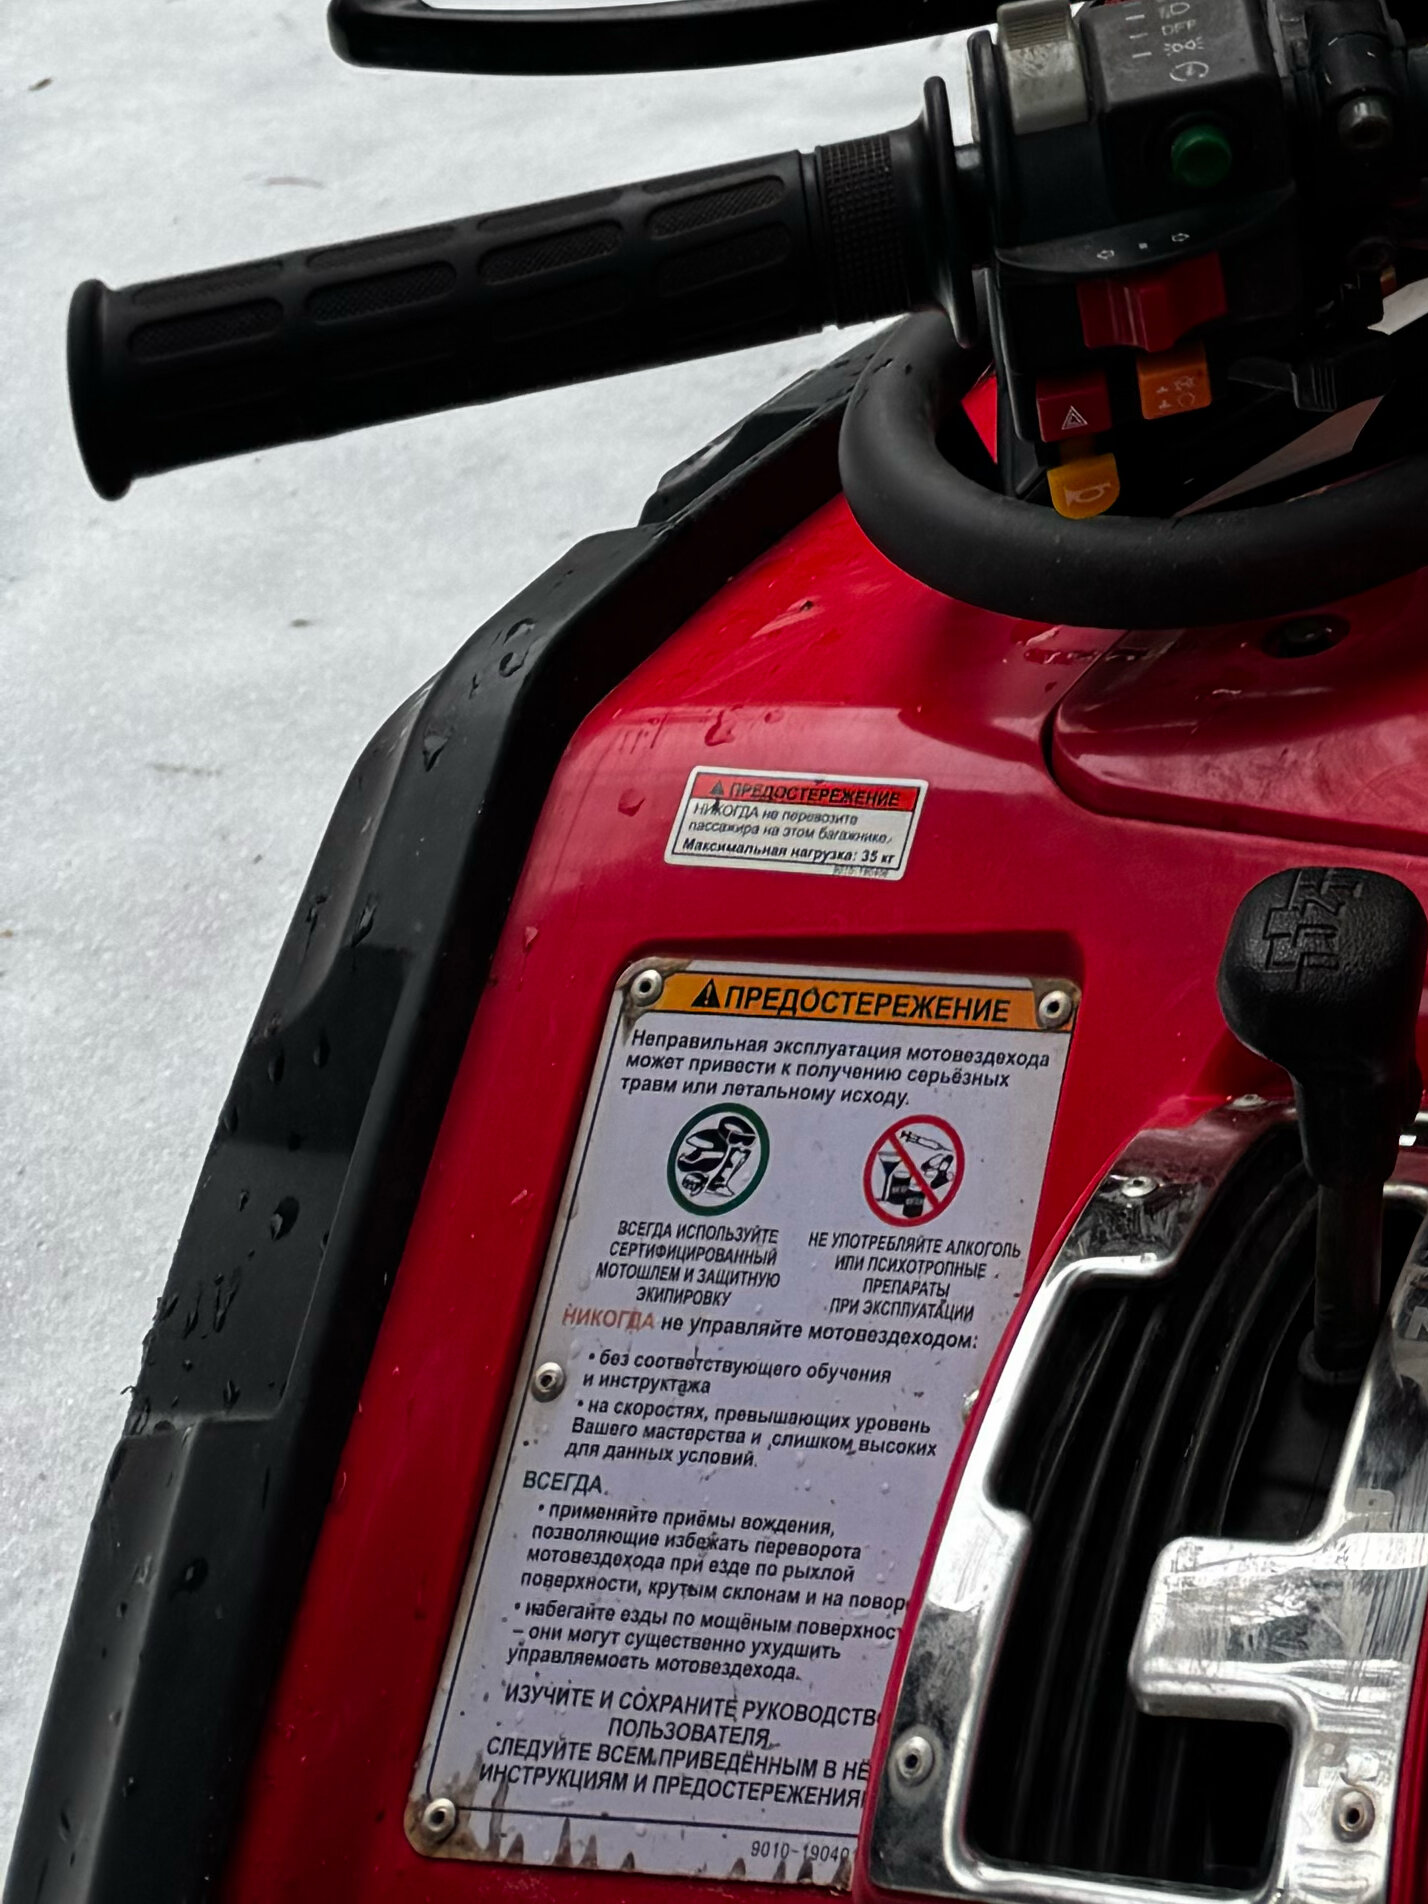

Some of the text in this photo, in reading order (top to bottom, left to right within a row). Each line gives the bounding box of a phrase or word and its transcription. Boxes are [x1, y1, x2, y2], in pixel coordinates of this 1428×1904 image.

[730, 782, 901, 807] ПРЕДОСТЕРЕЖЕНИЕ
[683, 838, 787, 857] Максимальная
[862, 849, 878, 863] 35
[882, 852, 895, 863] кг
[725, 986, 1011, 1023] ПРЕДОСТЕРЕЖЕНИЕ
[631, 1029, 1050, 1069] Неправильная эксплуатация мотовездехода
[625, 1054, 1010, 1088] может привести к получению серьёзных
[620, 1075, 910, 1108] травм или летальному исходу.
[617, 1220, 779, 1245] ВСЕГДА ИСПОЛЬЗУЙТЕ
[808, 1231, 1020, 1259] НЕ УПОТРЕБЛЯЙТЕ АЛКОГОЛЬ
[609, 1241, 778, 1267] СЕРТИФИЦИРОВАННЫЙ
[835, 1255, 985, 1279] ИЛИ ПСИХОТРОПНЫЕ
[596, 1263, 781, 1289] МОТОШЛЕМ И ЗАЩИТНУЮ
[862, 1278, 950, 1298] ПРЕПАРАТЫ
[636, 1286, 731, 1308] ЭКИПИРОВКУ
[829, 1298, 974, 1323] ПРИ ЭКСПЛУАТАЦИИ
[563, 1304, 977, 1351] НИКОГДА не управляйте мотовездеходом:
[600, 1350, 892, 1384] без соответствующего обучения
[583, 1374, 710, 1395] и инструктажа
[588, 1400, 931, 1435] на скоростях, превышающих уровень
[572, 1417, 937, 1458] Вашего мастерства и слишком высоких
[565, 1442, 758, 1468] для данных условий.
[549, 1503, 835, 1538] применяйте приёмы вождения,
[532, 1525, 861, 1561] позволяющие избежать переворота
[527, 1547, 855, 1584] мотовездехода при езде по рыхлой
[521, 1572, 642, 1595] поверхности,
[648, 1580, 717, 1601] крутым
[722, 1585, 800, 1605] склонам
[805, 1592, 817, 1605] и
[822, 1592, 843, 1608] на
[620, 1609, 668, 1627] езды
[673, 1612, 695, 1626] по
[700, 1613, 792, 1635] мощёным
[528, 1626, 841, 1660] они могут существенно ухудшить
[506, 1645, 801, 1681] управляемость мотовездехода.
[504, 1685, 881, 1727] ИЗУЧИТЕ И СОХРАНИТЕ РУКОВОДСТВ
[487, 1735, 592, 1761] СЛЕДУЙТЕ
[660, 1746, 819, 1779] ПРИВЕДЁННЫМ
[824, 1761, 837, 1780] В
[479, 1763, 627, 1793] ИНСТРУКЦИЯМ
[634, 1773, 647, 1790] И
